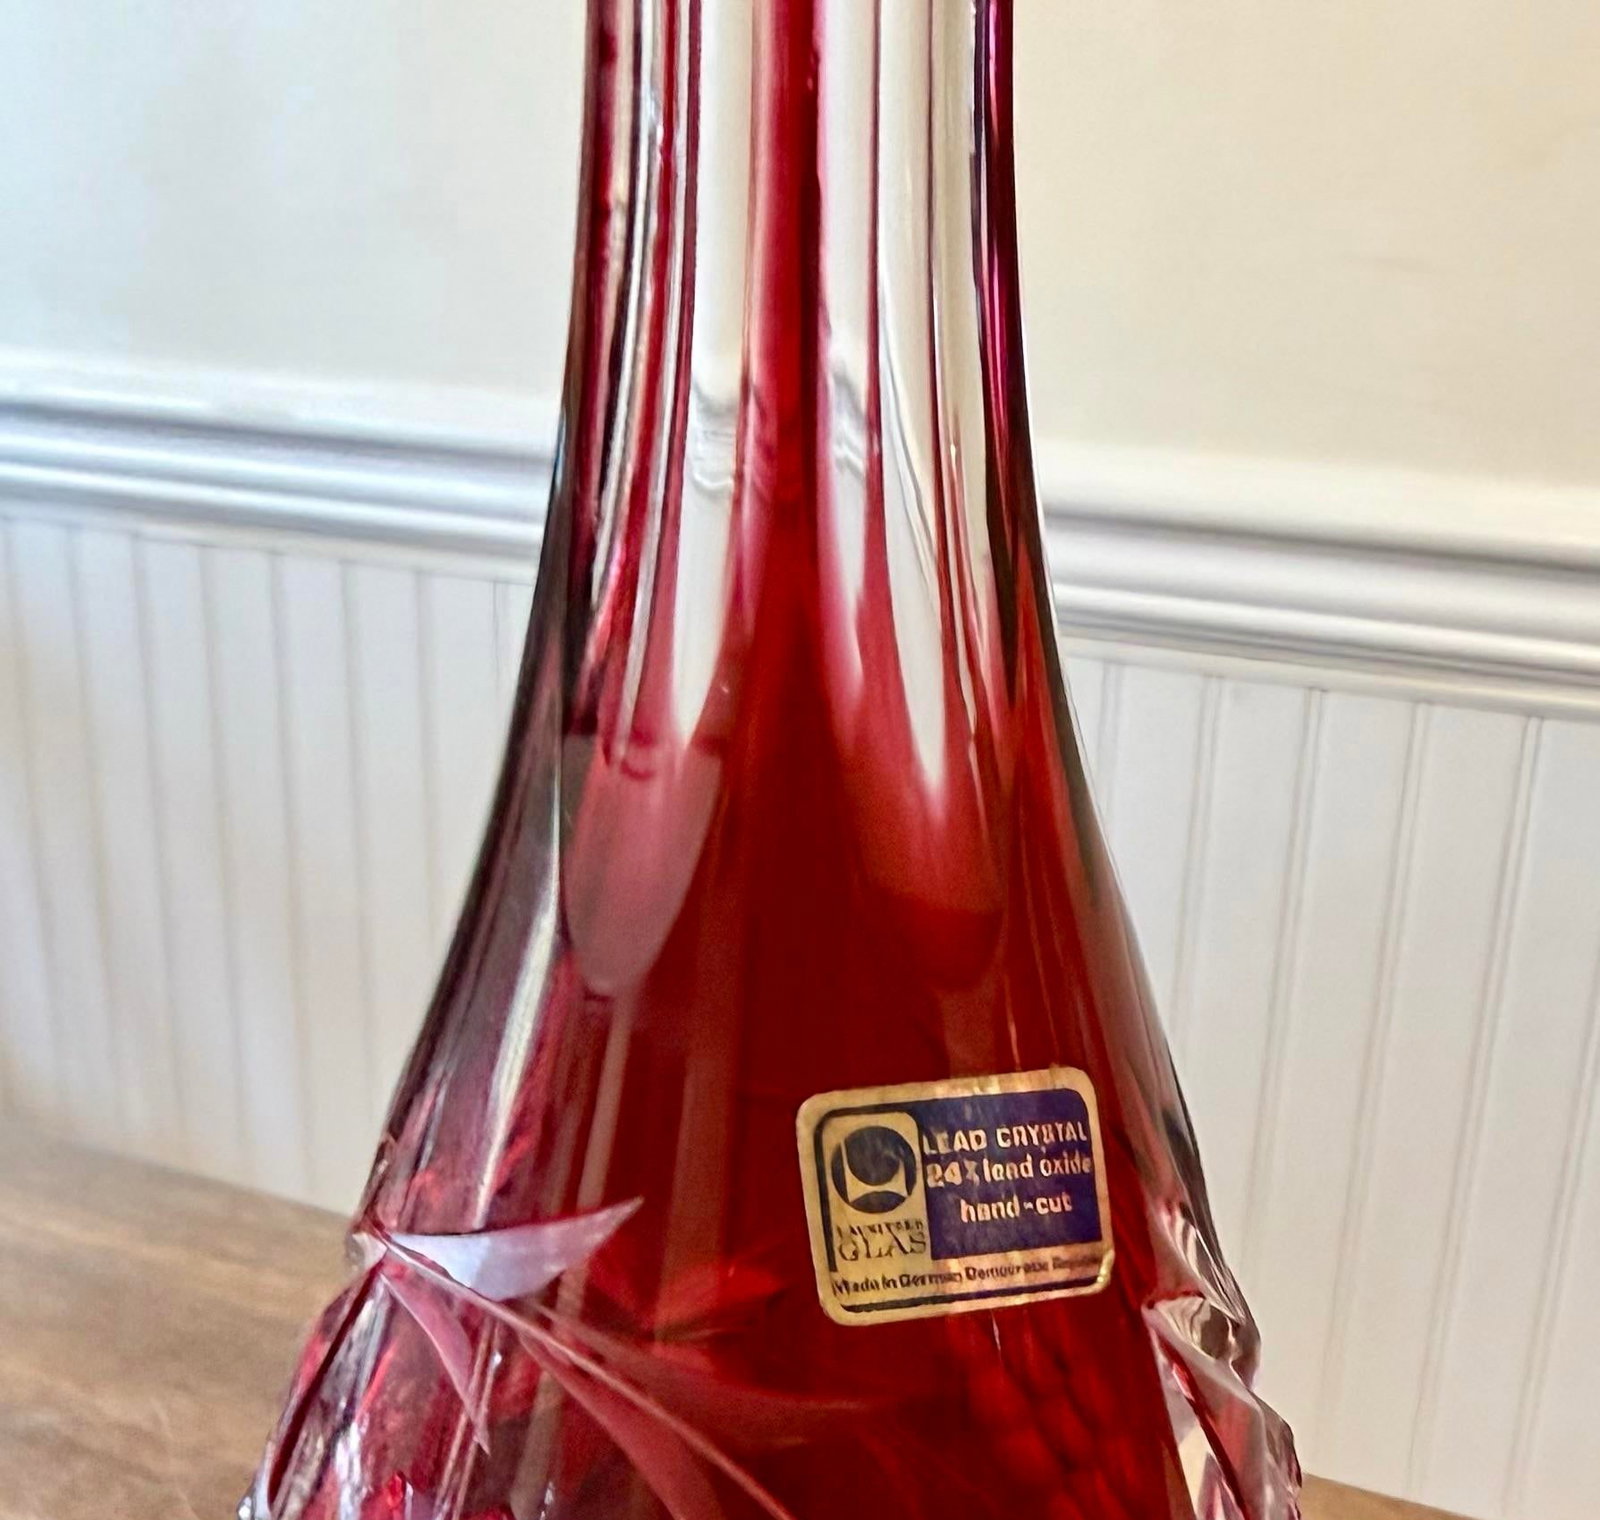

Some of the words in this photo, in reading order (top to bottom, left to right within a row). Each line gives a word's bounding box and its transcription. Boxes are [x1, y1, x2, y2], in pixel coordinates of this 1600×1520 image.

[923, 1127, 988, 1155] LEAD
[996, 1121, 1088, 1149] CRYSTAL
[1039, 1149, 1092, 1177] oxide
[838, 1230, 927, 1262] GLAS
